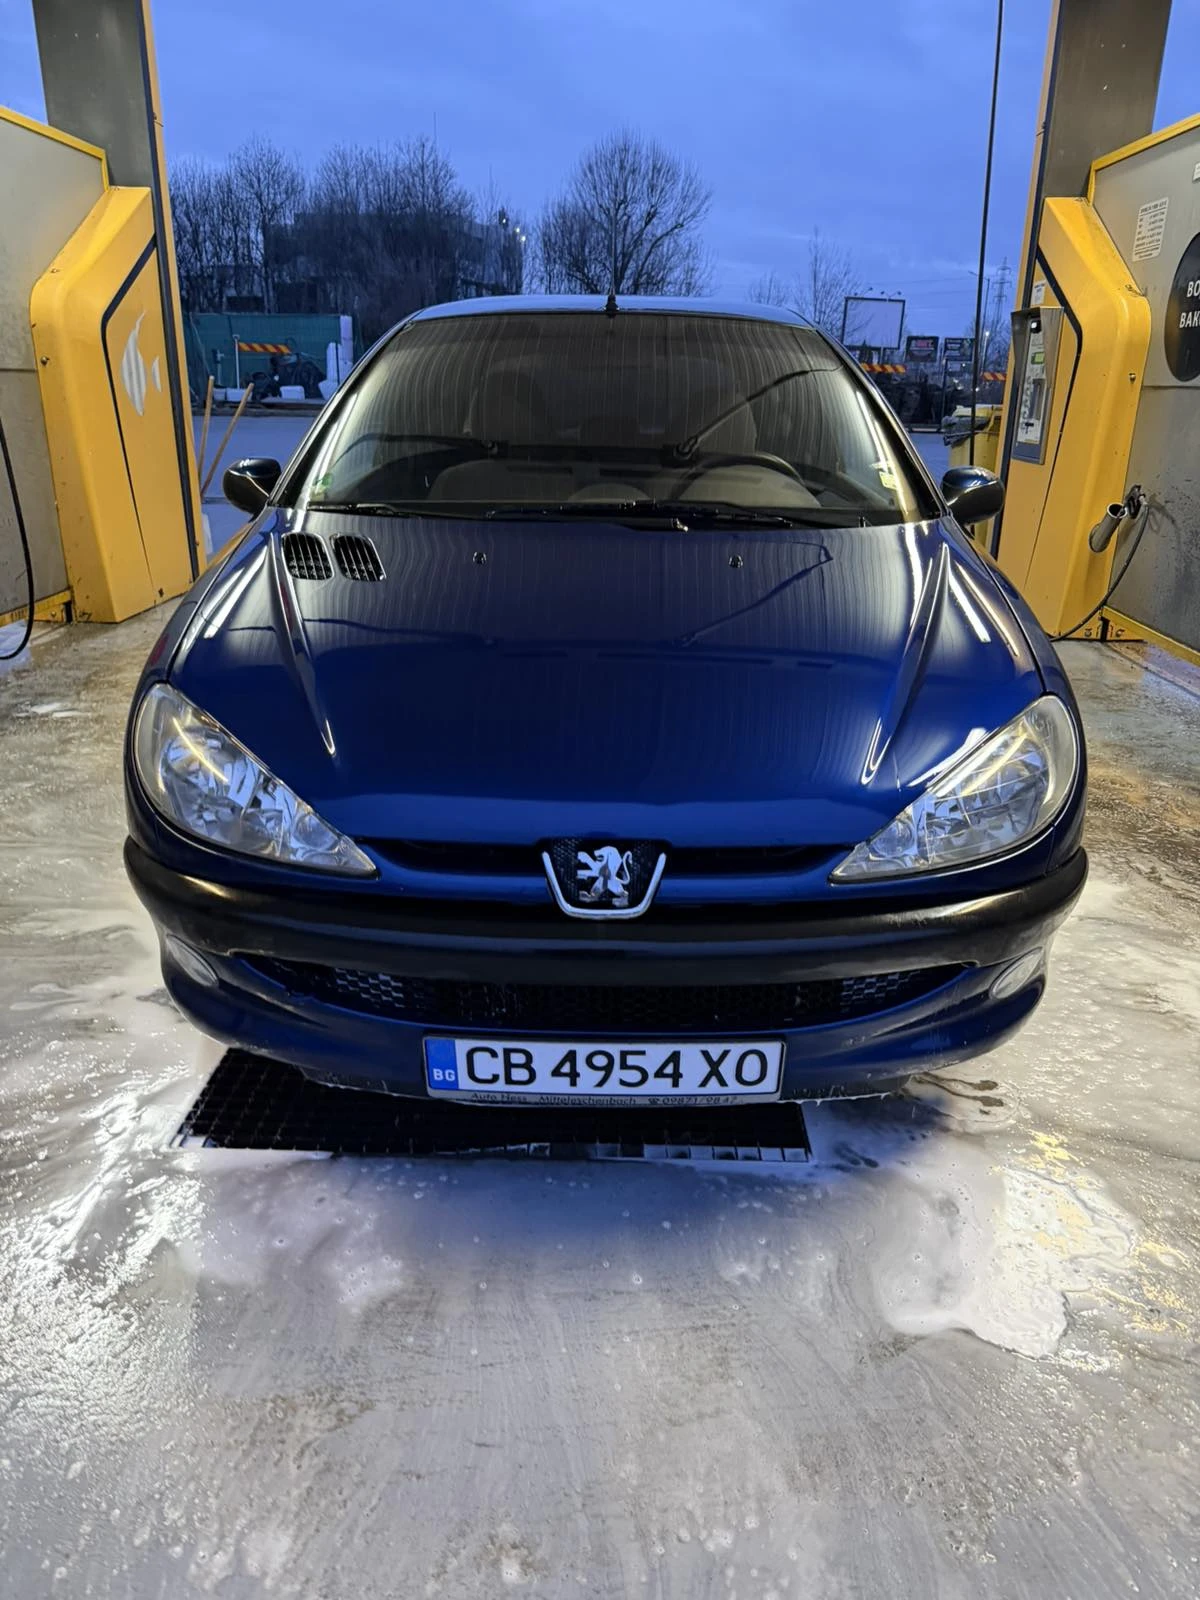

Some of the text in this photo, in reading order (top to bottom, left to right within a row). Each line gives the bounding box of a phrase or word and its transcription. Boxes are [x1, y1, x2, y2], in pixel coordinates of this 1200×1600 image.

[1186, 279, 1200, 299] ВО
[1179, 310, 1200, 328] ВАК
[433, 1068, 456, 1082] BG
[466, 1046, 768, 1089] CB 4954 XO
[471, 1092, 497, 1101] Auto
